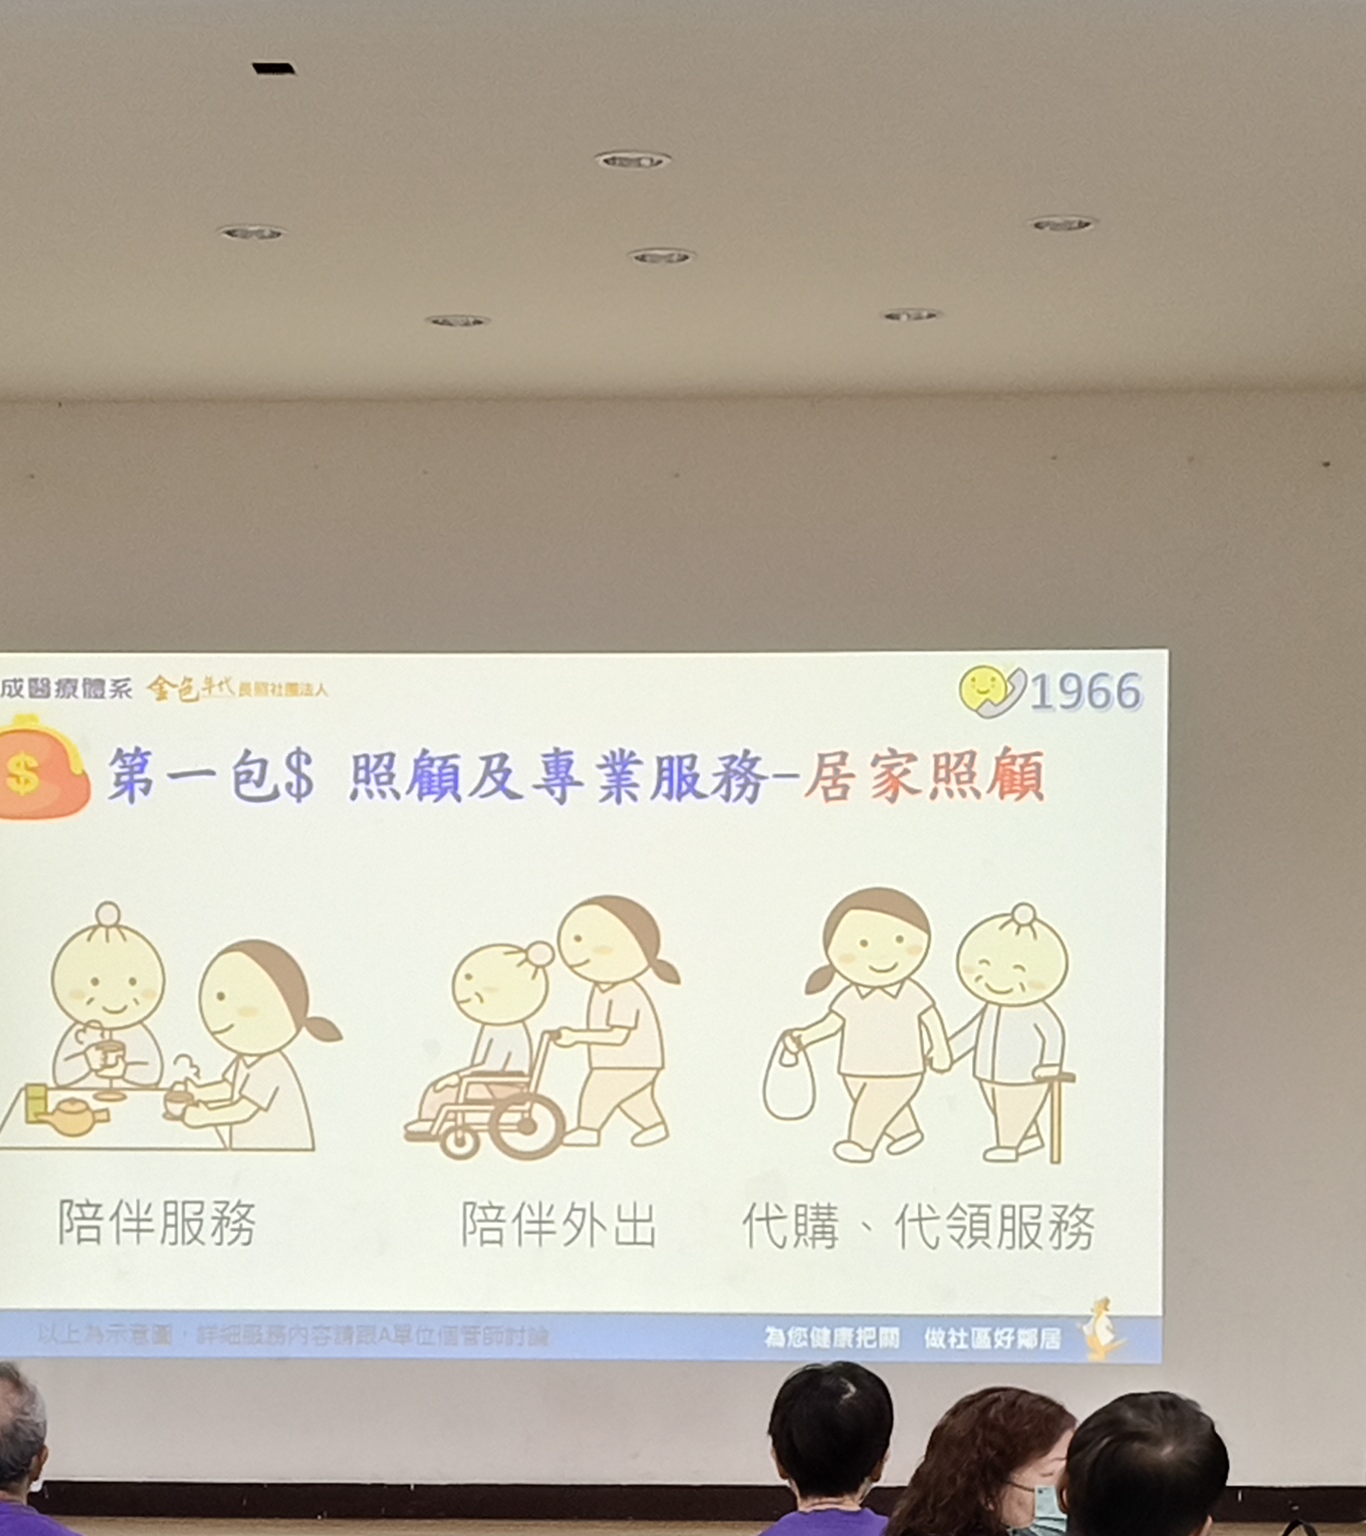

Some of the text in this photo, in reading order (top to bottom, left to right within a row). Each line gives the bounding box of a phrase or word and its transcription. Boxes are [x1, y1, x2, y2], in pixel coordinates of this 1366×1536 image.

[1030, 671, 1143, 712] 1966
[108, 745, 1047, 806] 第一包$ 照顧及專業服務-居家照顧
[58, 1198, 256, 1247] 陪伴服務
[462, 1200, 656, 1248] 陪伴外出
[741, 1201, 1096, 1251] 代購、代領服務
[765, 1325, 1062, 1351] 為您健康把關 做社區好鄰居
